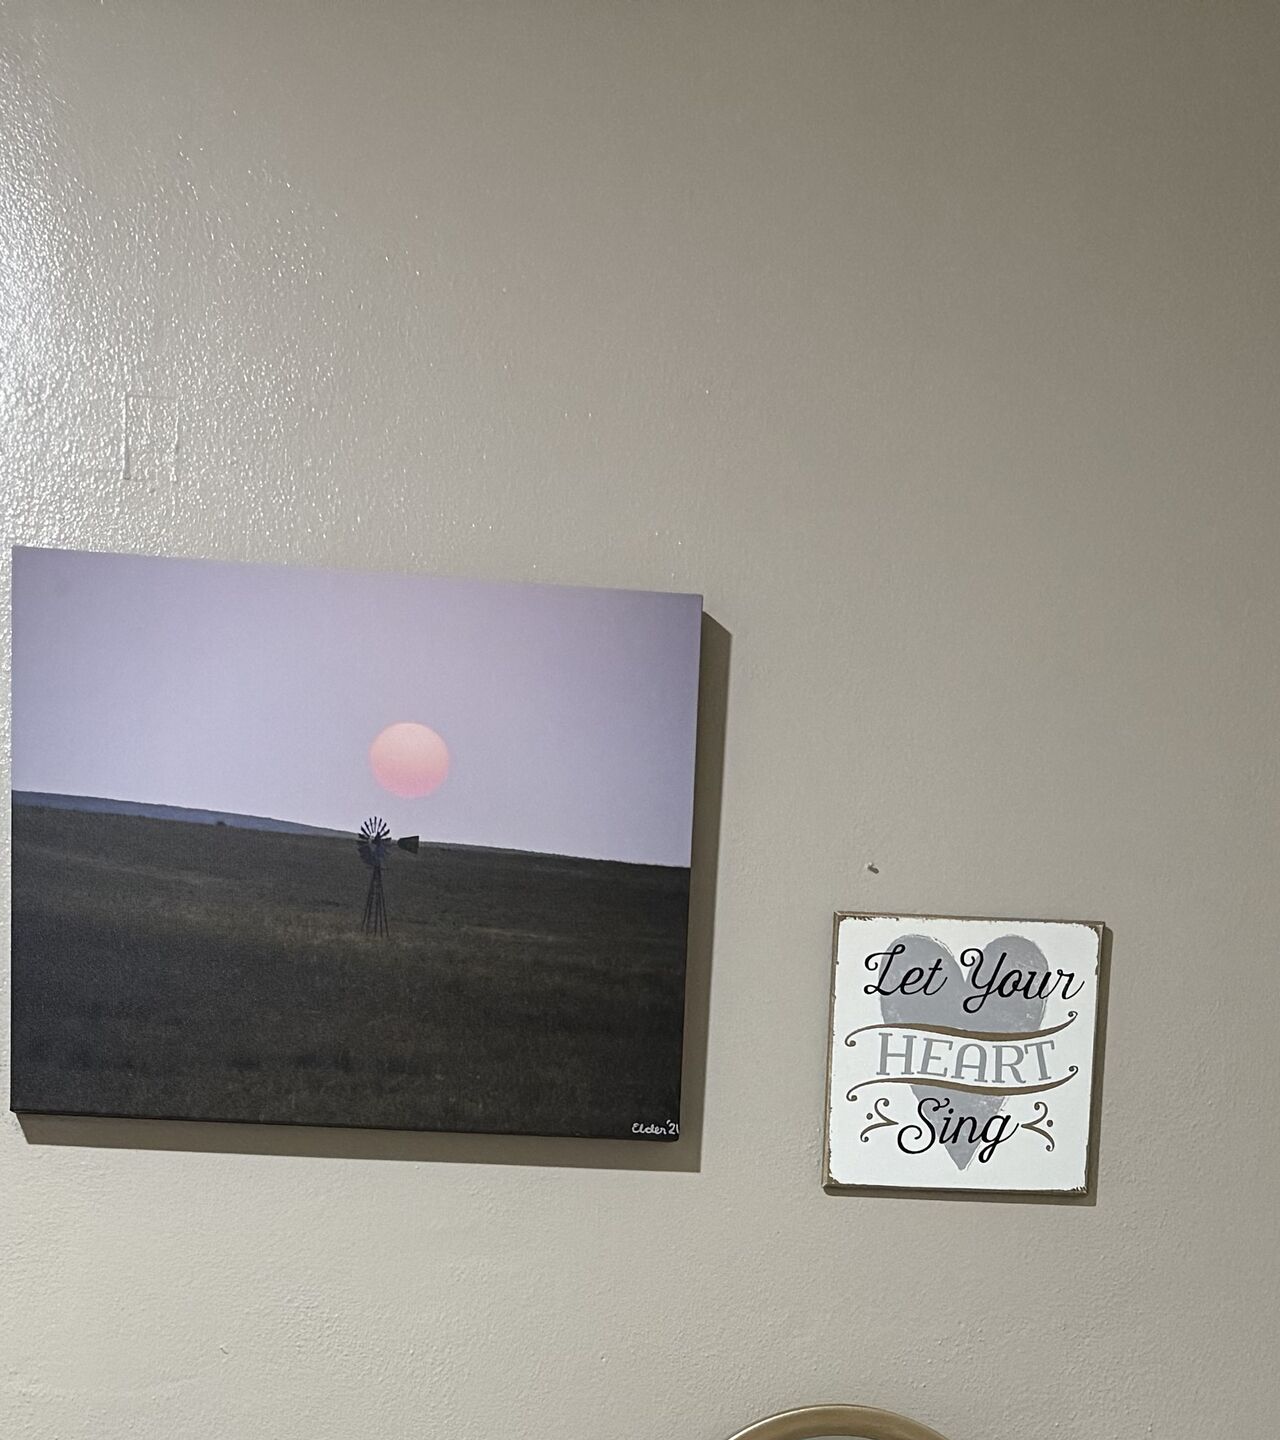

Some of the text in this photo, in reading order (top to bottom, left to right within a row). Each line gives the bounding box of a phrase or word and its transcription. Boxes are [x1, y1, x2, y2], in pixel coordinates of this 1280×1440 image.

[863, 943, 1086, 1014] Let Your
[876, 1032, 1056, 1084] HEART
[897, 1097, 1020, 1164] Sing
